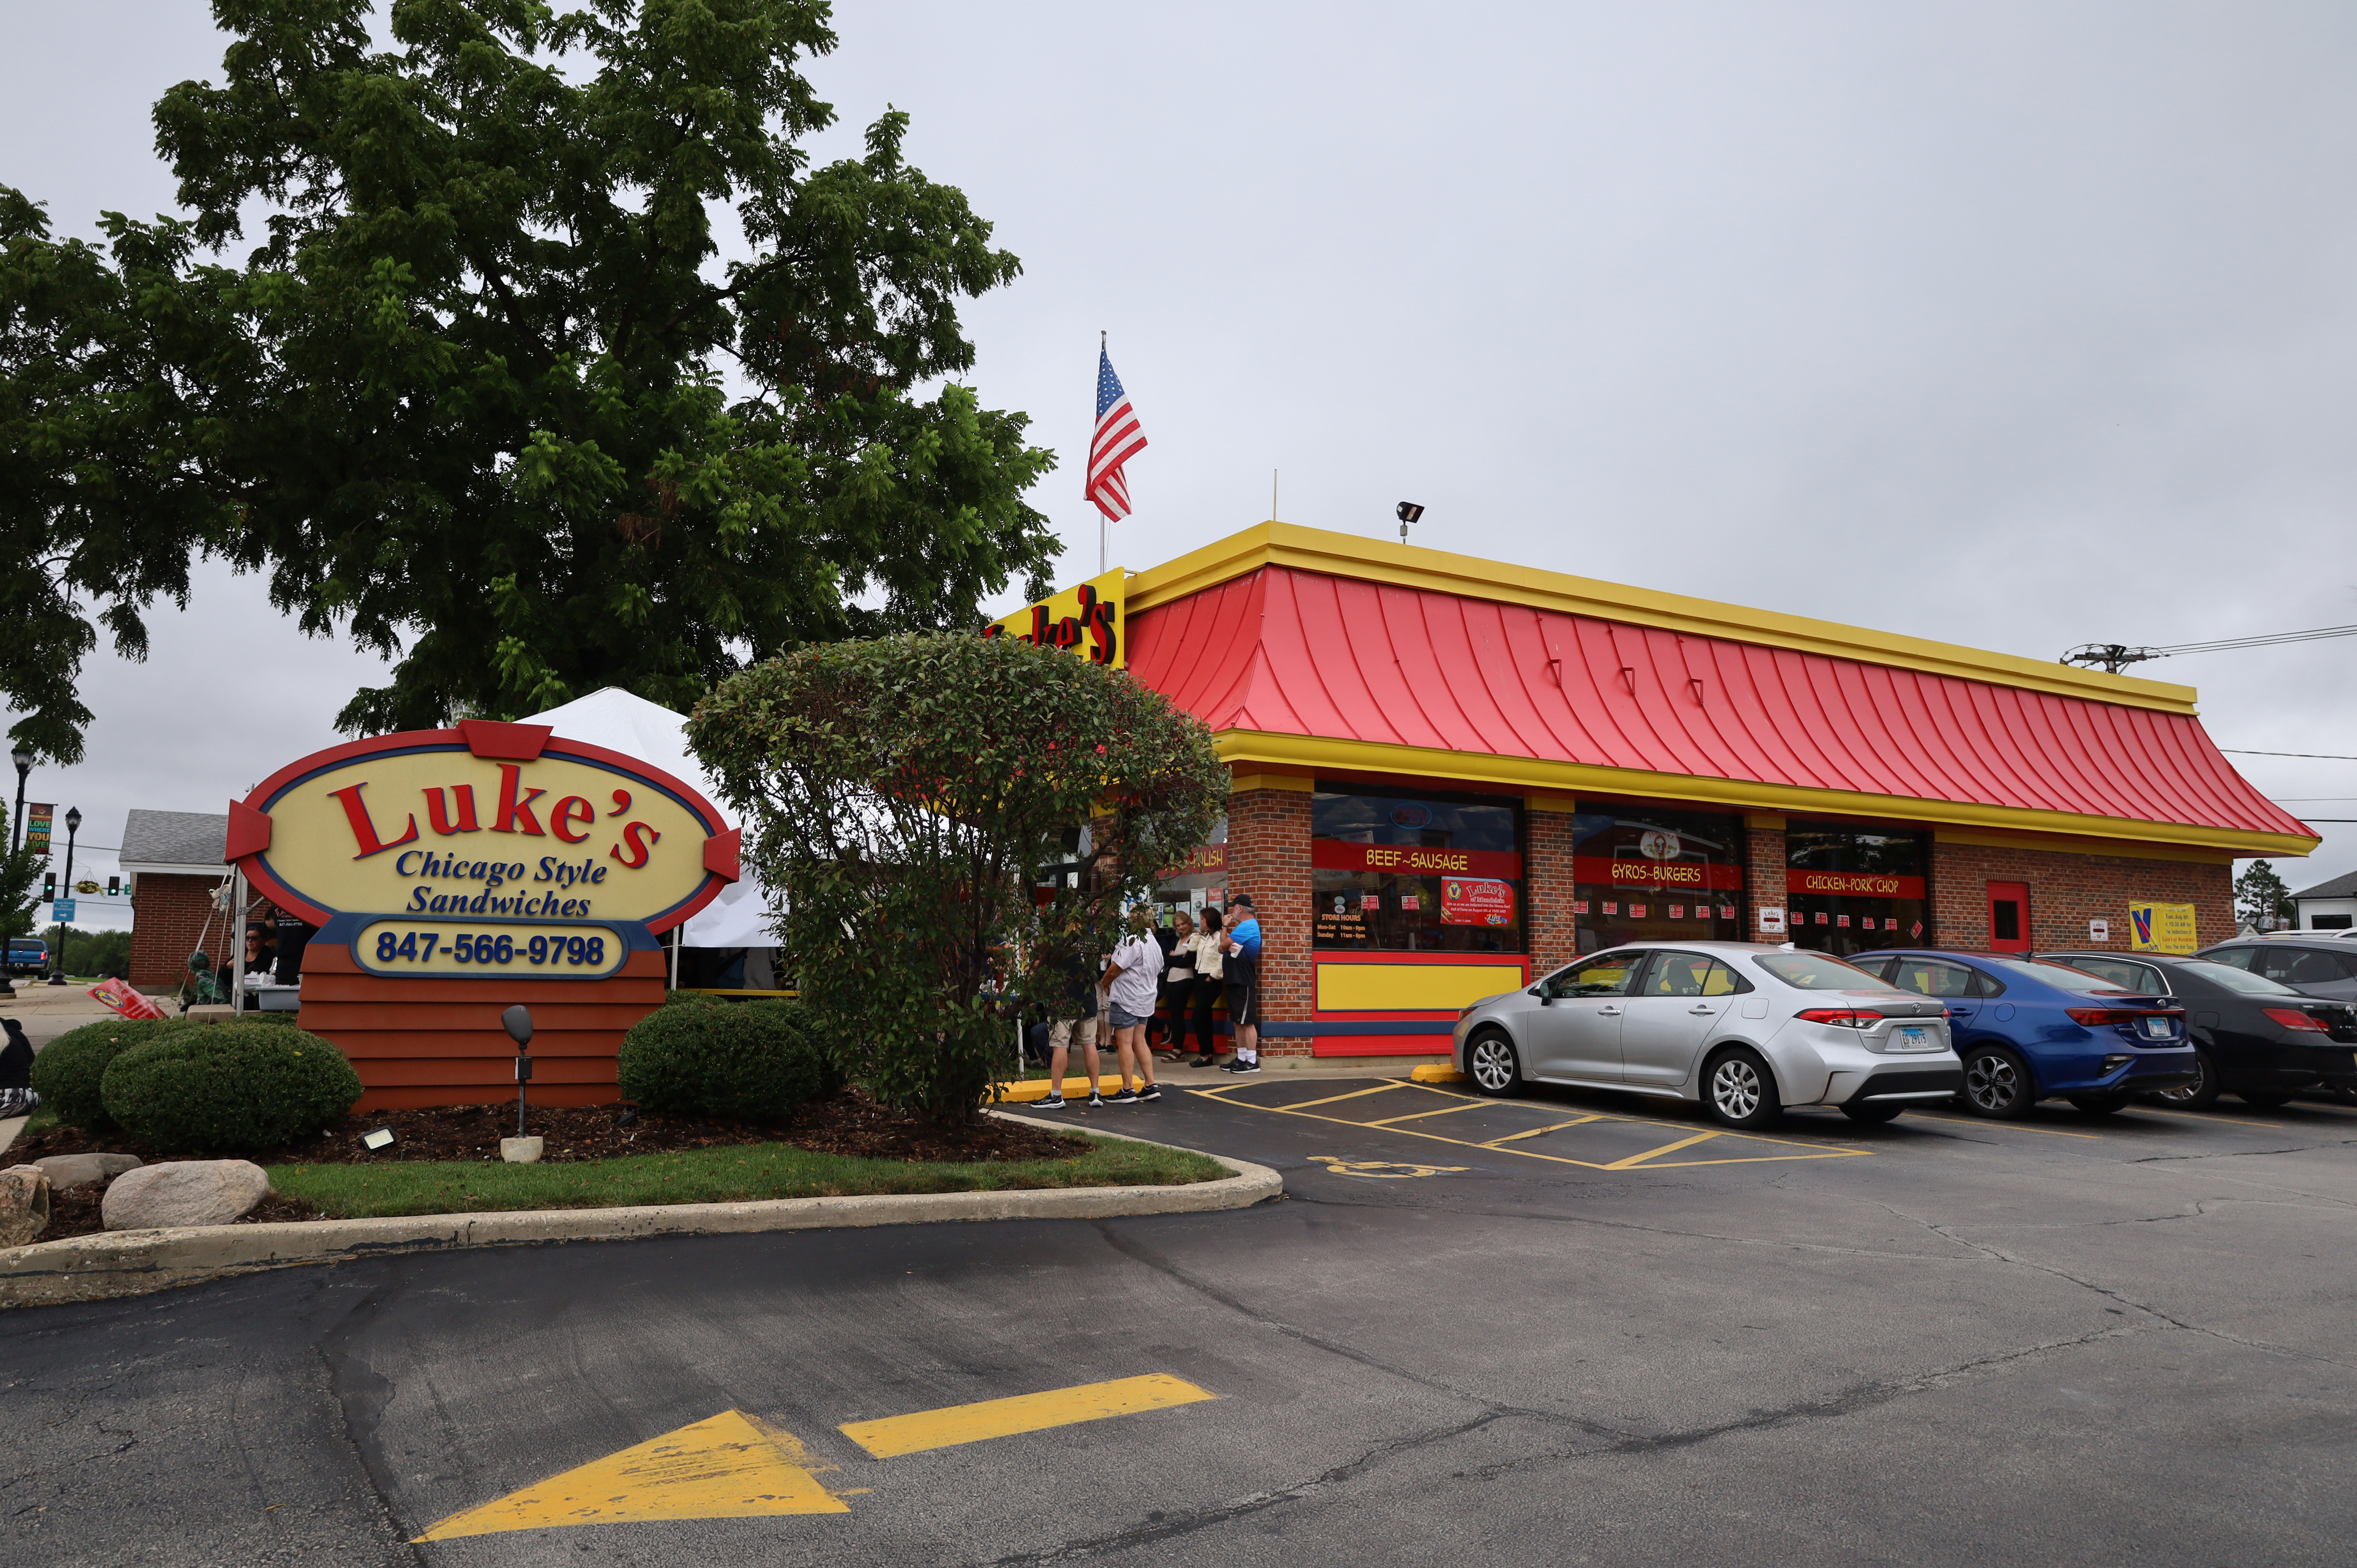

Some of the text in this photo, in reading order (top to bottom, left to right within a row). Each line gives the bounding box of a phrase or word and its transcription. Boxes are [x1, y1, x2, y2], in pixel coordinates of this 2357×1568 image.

[327, 762, 661, 868] Luke's
[1393, 808, 1429, 824] OPEN
[28, 832, 50, 841] YOU
[397, 850, 607, 889] Chicago Style
[1466, 882, 1505, 898] Luke's
[1877, 880, 1898, 893] CHOP
[406, 886, 590, 917] Sandwiches
[377, 932, 605, 965] 847-566-9798
[1902, 1033, 1926, 1044] EG 29175
